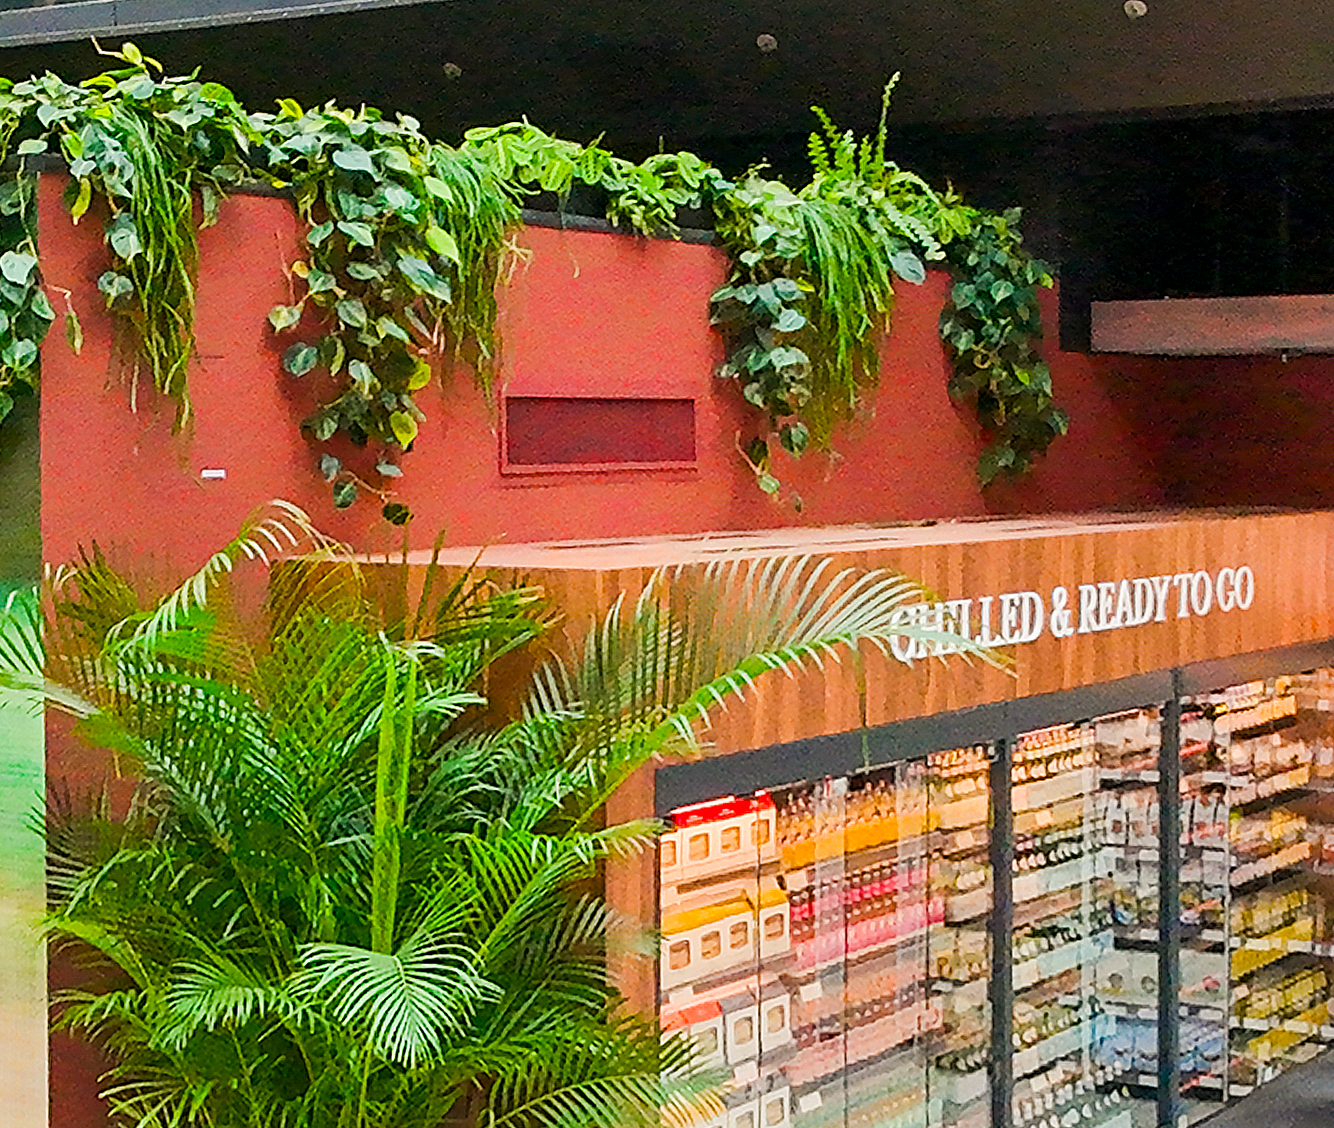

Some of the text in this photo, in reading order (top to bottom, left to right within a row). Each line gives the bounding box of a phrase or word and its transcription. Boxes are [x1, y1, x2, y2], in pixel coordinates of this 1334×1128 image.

[1050, 586, 1074, 637] &
[1078, 574, 1168, 634] READY
[1172, 570, 1213, 618] TO
[1216, 566, 1255, 613] GO
